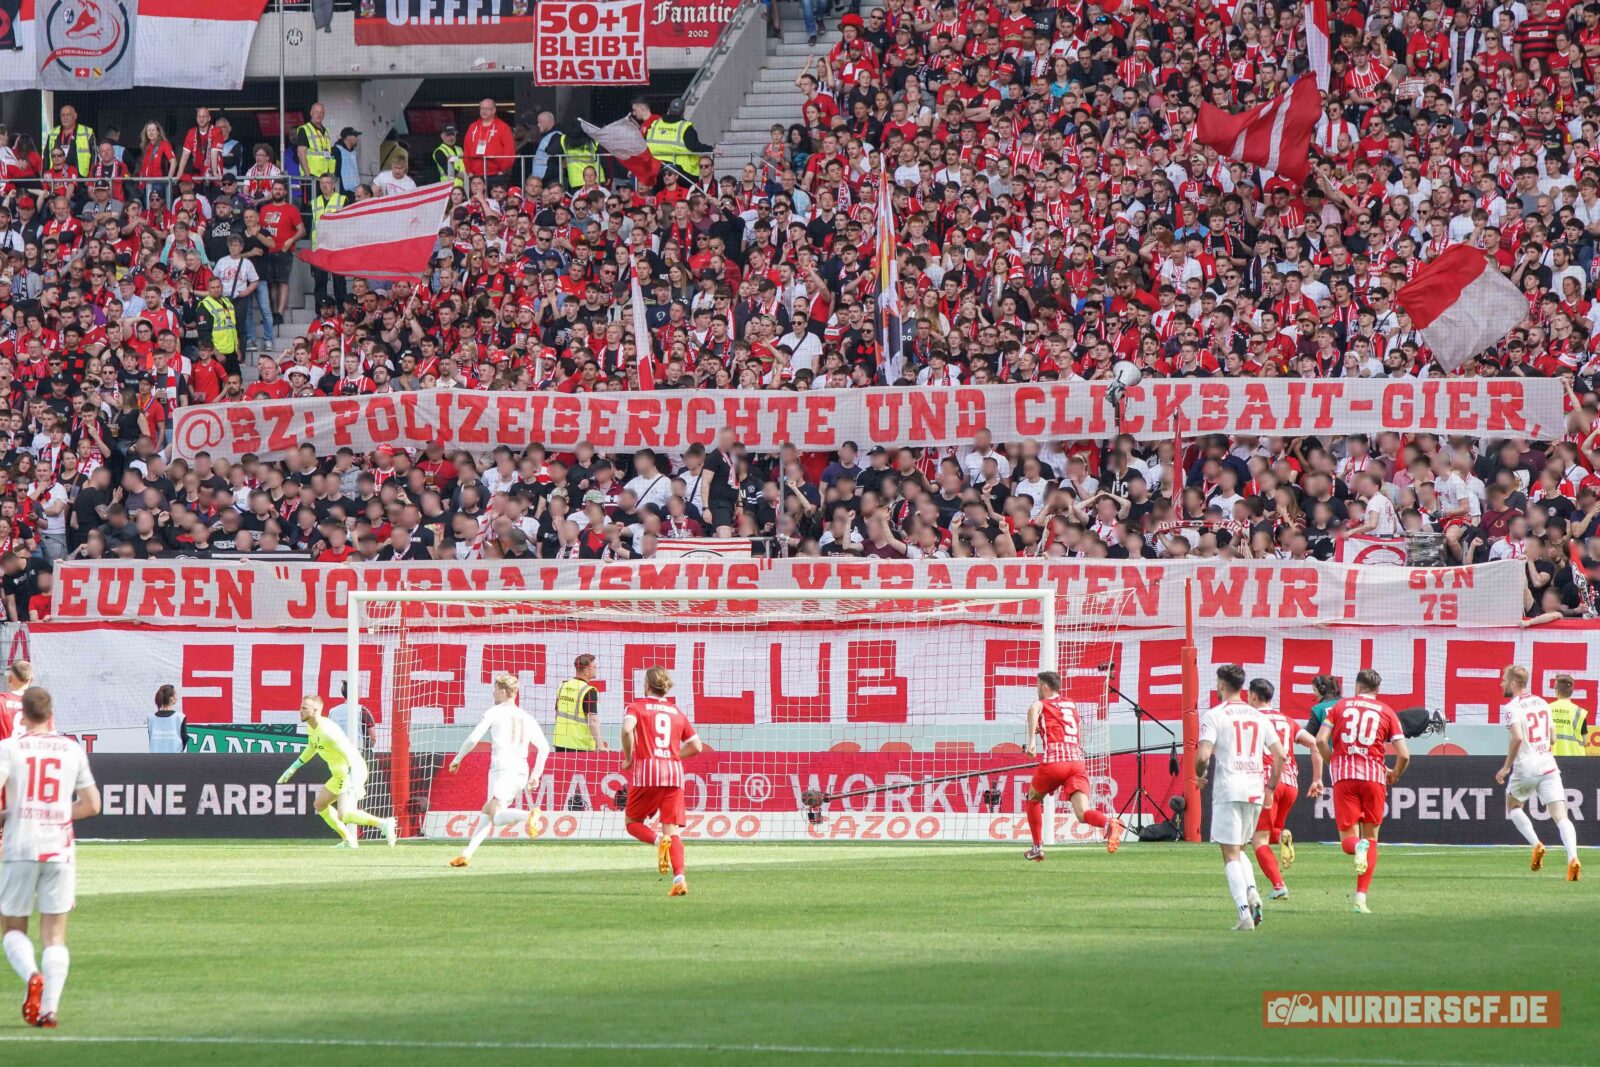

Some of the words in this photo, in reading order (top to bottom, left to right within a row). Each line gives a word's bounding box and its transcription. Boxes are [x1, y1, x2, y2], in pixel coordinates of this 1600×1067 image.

[540, 4, 642, 34] 50+1
[687, 30, 709, 38] 2002
[540, 35, 642, 57] BLEIBT.
[540, 59, 641, 80] BASTA!
[175, 404, 315, 459] @BZ:
[330, 393, 836, 446] POLIZEIBERICHTE
[866, 389, 987, 442] UND
[1015, 381, 1541, 437] CLICKBAIT-GIER,
[57, 566, 255, 619] EUREN
[275, 558, 773, 619] "JOURNALISMUS"
[792, 563, 1165, 616] VERACHTEN
[1197, 567, 1319, 618] WIR
[1408, 566, 1474, 589] SYN
[182, 640, 907, 725] SPORTCLUB
[985, 635, 1598, 726] FREIBURG
[655, 712, 671, 748] 9
[1233, 720, 1258, 757] 17
[1341, 707, 1380, 746] 30
[1526, 710, 1549, 743] 27
[27, 757, 61, 804] 16
[512, 773, 771, 812] MASOT®
[103, 784, 187, 816] EINE
[197, 784, 325, 816] ARBEIT
[1315, 787, 1493, 820] RPEKT
[808, 815, 941, 839] CAZOO
